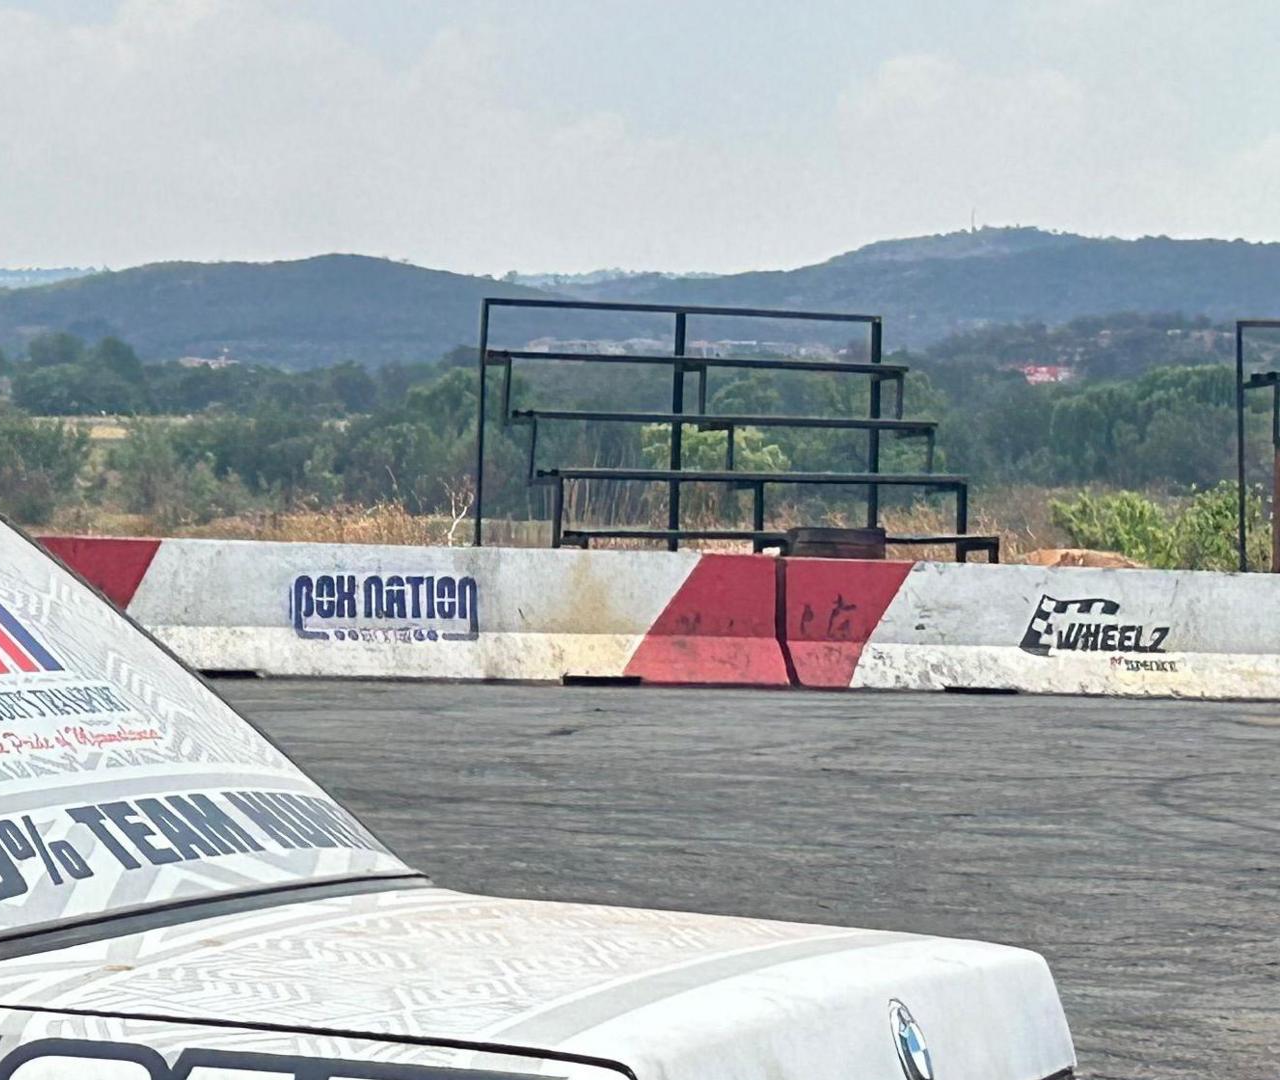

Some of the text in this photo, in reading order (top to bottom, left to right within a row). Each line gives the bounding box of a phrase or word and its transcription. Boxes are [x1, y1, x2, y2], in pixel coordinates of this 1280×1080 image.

[363, 575, 479, 622] NATION
[1056, 622, 1170, 653] WHEELZ
[28, 686, 131, 717] TRANSPORT
[3, 731, 54, 753] Pride
[55, 729, 75, 751] of
[65, 791, 267, 870] TEAM
